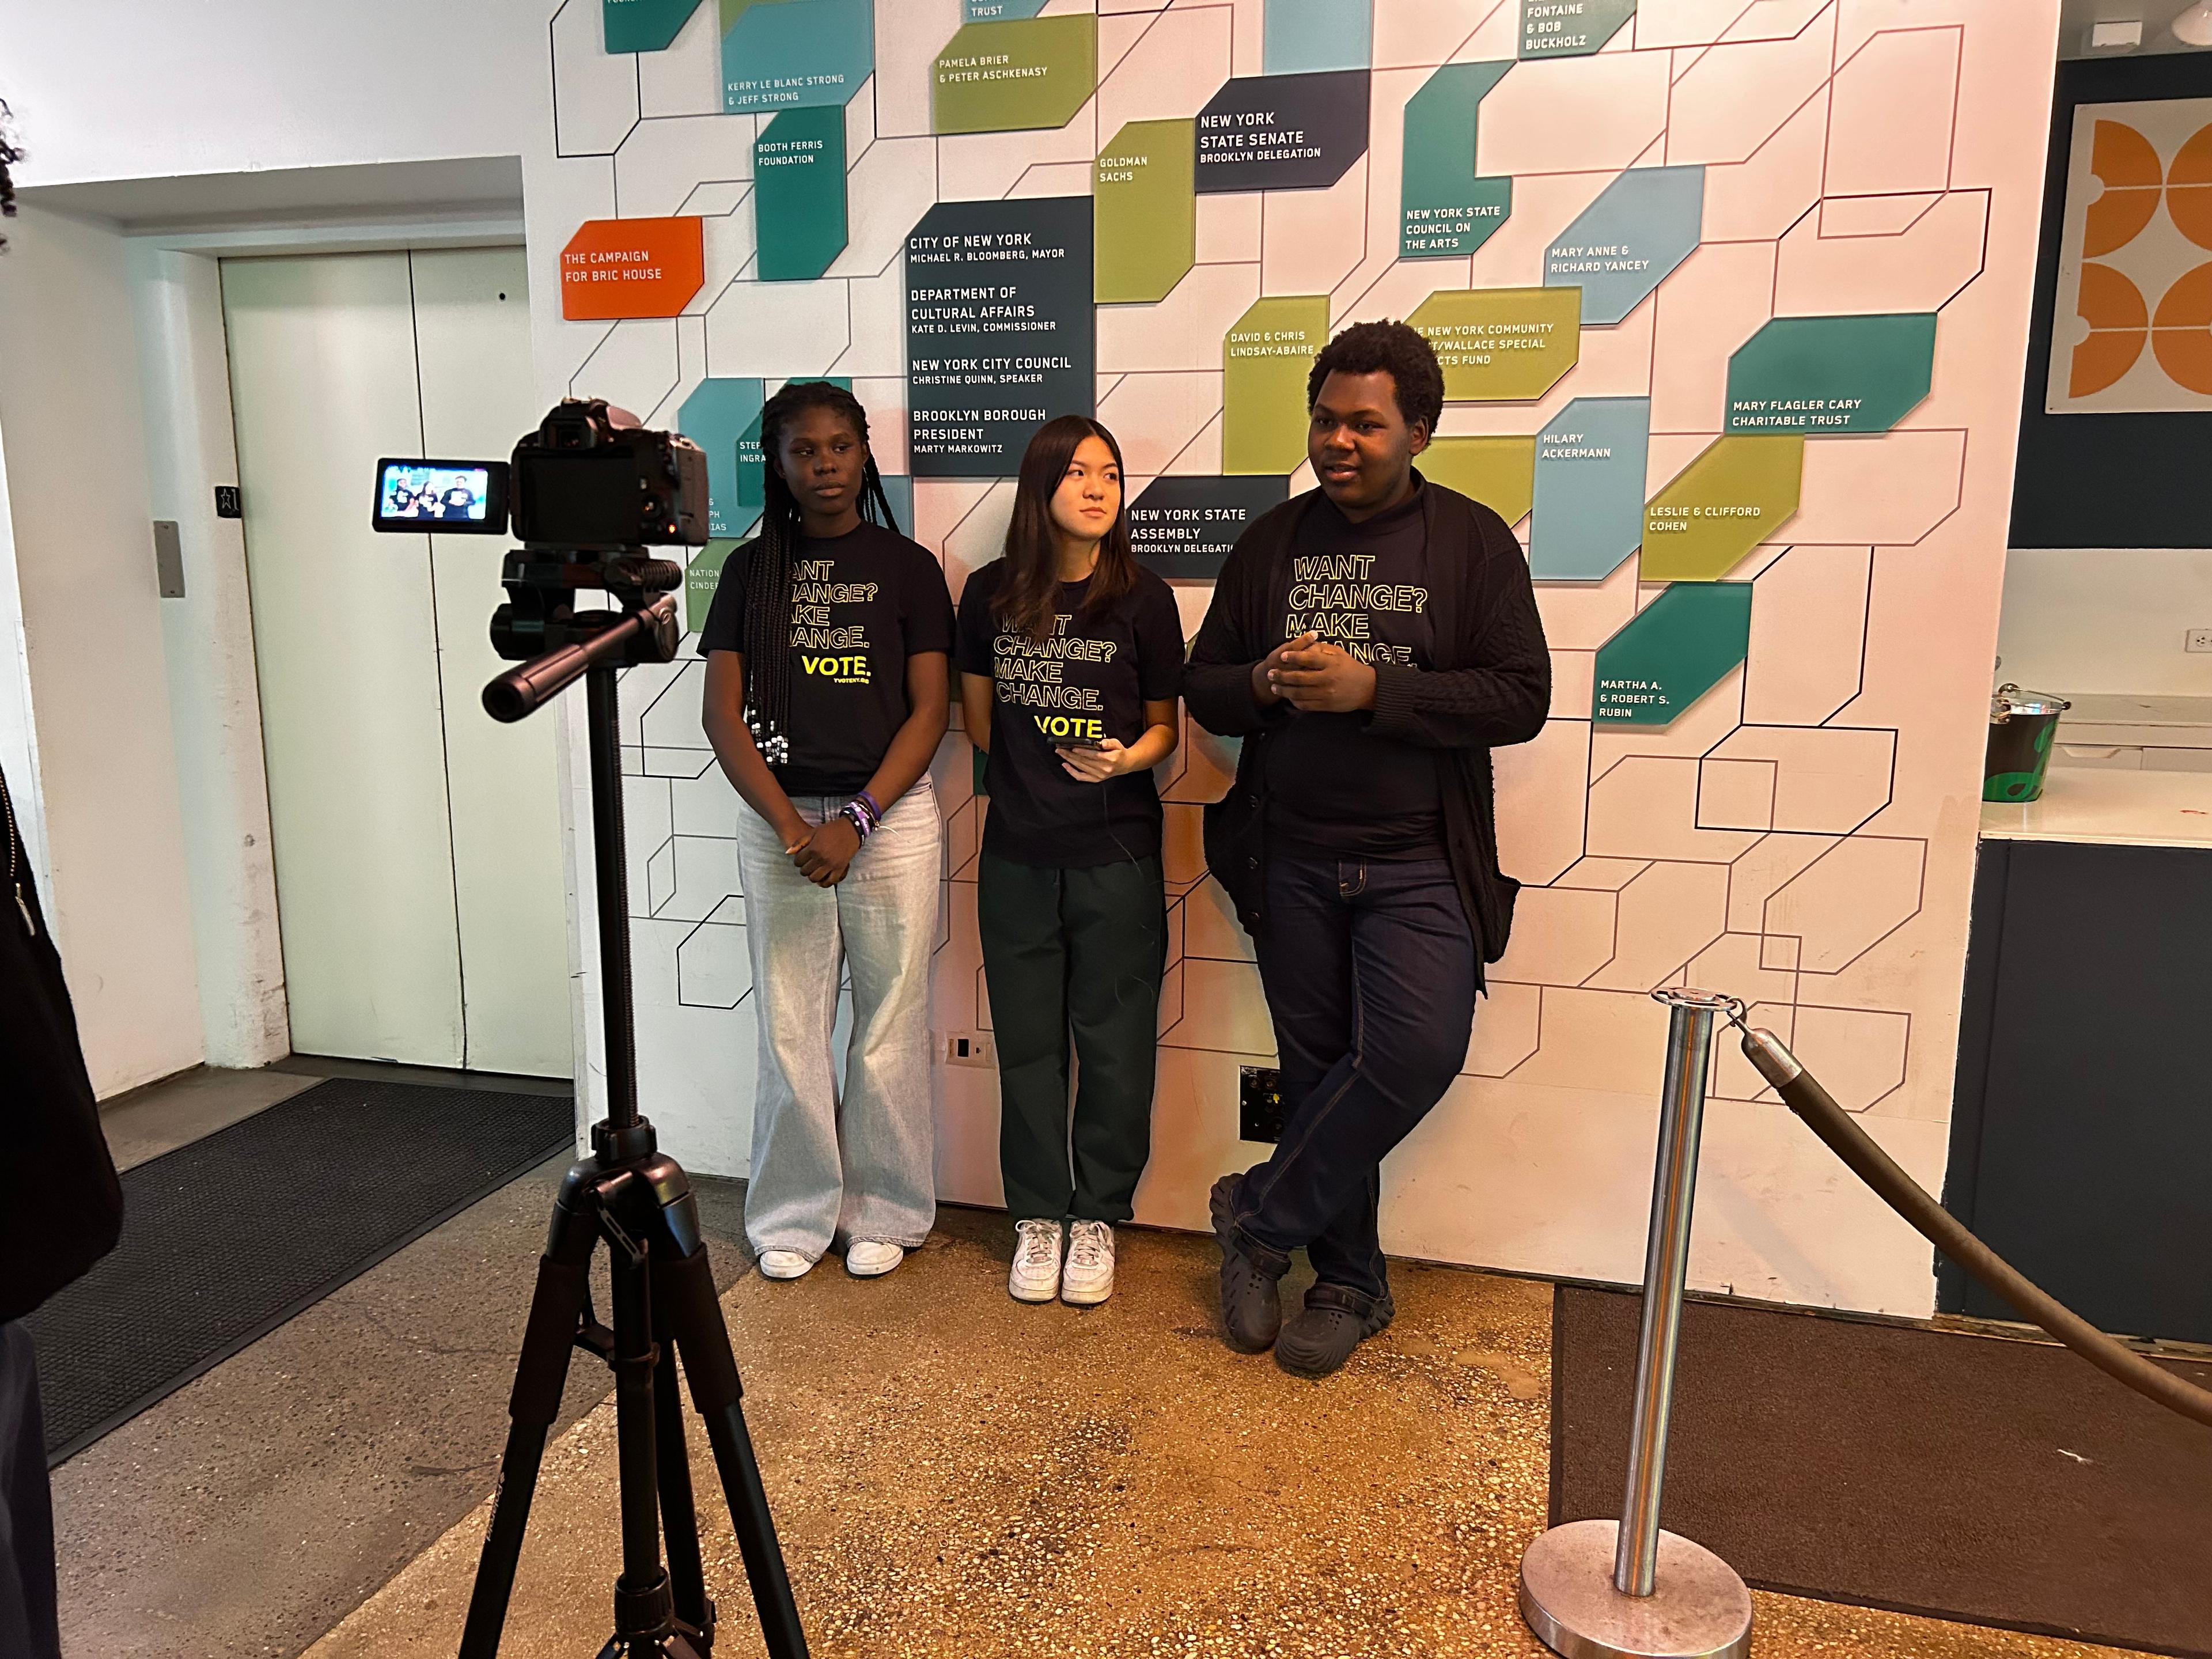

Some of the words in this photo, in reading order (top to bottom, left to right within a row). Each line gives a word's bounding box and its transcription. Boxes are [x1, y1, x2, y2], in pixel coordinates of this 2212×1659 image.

[972, 6, 1002, 16] TRUST
[1528, 3, 1583, 18] FONTAINE
[1527, 24, 1534, 33] &
[1539, 21, 1560, 32] BOB
[1526, 35, 1586, 50] BUCKHOLZ
[940, 58, 976, 68] PAMELA
[980, 55, 1008, 65] BRIER
[949, 72, 979, 82] PETER
[983, 67, 1047, 79] ASCHKENASY
[728, 82, 756, 90] KERRY
[761, 80, 770, 89] LE
[775, 78, 802, 88] BLANC
[807, 75, 843, 85] STRONG
[738, 95, 758, 104] JEFF
[762, 92, 798, 102] STRONG
[1202, 115, 1231, 128] NEW
[1236, 112, 1274, 126] YORK
[1201, 135, 1243, 148] STATE
[1249, 131, 1303, 145] SENATE
[759, 143, 787, 152] BOOTH
[791, 141, 823, 150] FERRIS
[759, 155, 813, 165] FOUNDATION
[1200, 151, 1253, 163] BROOKLYN
[1257, 148, 1320, 160] DELEGATION
[1100, 157, 1147, 167] GOLDMAN
[1100, 172, 1132, 181] SACHS
[1407, 210, 1430, 219] NEW
[1434, 208, 1462, 218] YORK
[1467, 206, 1500, 217] STATE
[1407, 224, 1452, 234] COUNCIL
[1456, 223, 1470, 232] ON
[911, 237, 938, 249] CITY
[944, 236, 959, 248] OF
[965, 235, 991, 247] NEW
[997, 233, 1031, 245] YORK
[1406, 240, 1426, 249] THE
[1430, 238, 1458, 248] ARTS
[565, 253, 585, 264] THE
[590, 251, 648, 263] CAMPAIGN
[911, 253, 950, 263] MICHAEL
[955, 253, 963, 261] R.
[967, 251, 1028, 260] BLOOMBERG,
[1032, 249, 1064, 258] MAYOR
[1552, 247, 1583, 257] MARY
[1587, 246, 1617, 256] ANNE
[1622, 246, 1628, 255] &
[1551, 262, 1600, 272] RICHARD
[1605, 260, 1649, 270] YANCEY
[566, 272, 587, 282] FOR
[592, 270, 618, 281] BRIC
[623, 268, 661, 279] HOUSE
[911, 287, 995, 301] DEPARTMENT
[1001, 287, 1016, 298] OF
[912, 308, 975, 319] CULTURAL
[980, 305, 1034, 317] AFFAIRS
[912, 325, 934, 333] KATE
[950, 324, 979, 332] LEVIN,
[984, 322, 1055, 331] COMMISSIONER
[1428, 327, 1451, 336] NEW
[1455, 325, 1484, 335] YORK
[1488, 324, 1554, 334] COMMUNITY
[1232, 333, 1260, 342] DAVID
[1264, 332, 1271, 341] &
[1275, 331, 1305, 341] CHRIS
[1231, 345, 1313, 356] LINDSAY-ABAIRE
[1433, 340, 1494, 350] T/WALLACE
[1499, 339, 1546, 349] SPECIAL
[913, 360, 939, 370] NEW
[944, 359, 977, 370] YORK
[983, 358, 1010, 369] CITY
[1016, 357, 1071, 369] COUNCIL
[1463, 355, 1490, 364] FUND
[913, 376, 961, 384] CHRISTINE
[965, 375, 996, 384] QUINN,
[1000, 374, 1042, 382] SPEAKER
[1734, 402, 1766, 411] MARY
[1771, 400, 1824, 410] FLAGLER
[1829, 400, 1861, 409] CARY
[914, 410, 978, 421] BROOKLYN
[984, 410, 1045, 421] BOROUGH
[1733, 416, 1805, 426] CHARITABLE
[1810, 415, 1850, 425] TRUST
[914, 429, 983, 439] PRESIDENT
[1544, 434, 1584, 443] HILARY
[948, 445, 1002, 453] MARKOWITZ
[1542, 448, 1610, 457] ACKERMANN
[1132, 510, 1159, 520] NEW
[1164, 510, 1199, 520] YORK
[1205, 509, 1245, 520] STATE
[1651, 507, 1689, 516] LESLIE
[1694, 507, 1700, 516] &
[1705, 507, 1760, 516] CLIFFORD
[1650, 522, 1687, 530] COHEN
[1131, 528, 1200, 539] ASSEMBLY
[1131, 544, 1180, 552] BROOKLYN
[1184, 544, 1233, 552] DELEGATI
[793, 560, 834, 581] ANT
[1294, 554, 1376, 581] WANT
[791, 582, 878, 604] ANGE?
[1289, 584, 1427, 613] CHANGE?
[791, 605, 830, 626] KE
[1002, 613, 1072, 635] WT
[1286, 612, 1370, 639] MAKE
[789, 626, 869, 649] ANGE.
[994, 635, 1117, 662] CHANGE?
[802, 656, 871, 676] VOTE.
[994, 657, 1063, 683] MAKE
[1601, 680, 1646, 689] MARTHA
[1650, 681, 1661, 690] A.
[997, 681, 1103, 710] CHANGE.
[1611, 695, 1655, 703] ROBERT
[1659, 696, 1669, 704] S.
[1600, 708, 1631, 717] RUBIN
